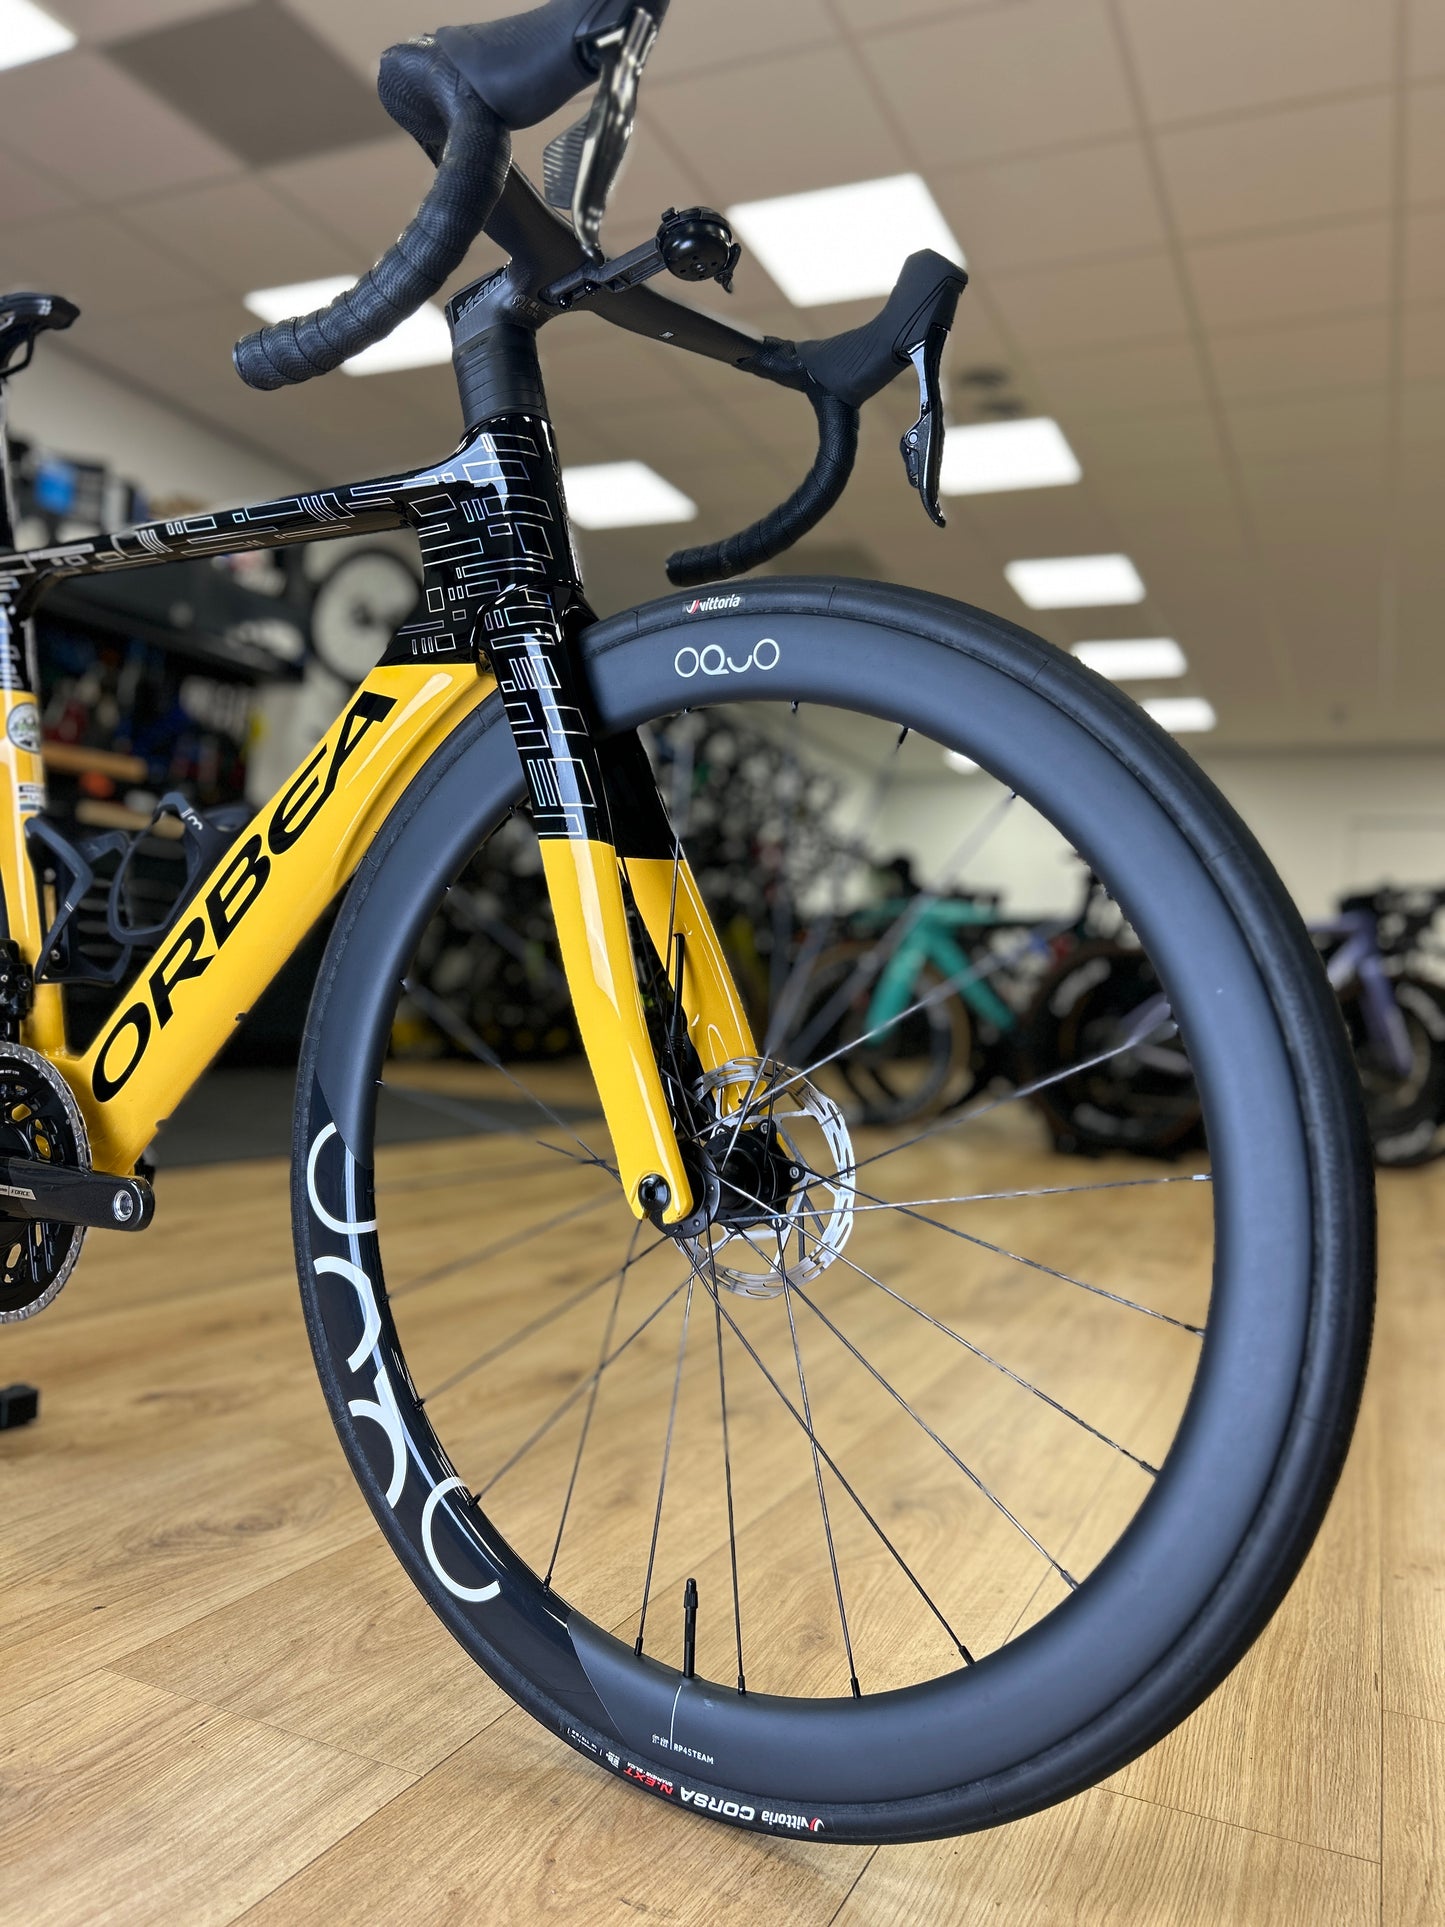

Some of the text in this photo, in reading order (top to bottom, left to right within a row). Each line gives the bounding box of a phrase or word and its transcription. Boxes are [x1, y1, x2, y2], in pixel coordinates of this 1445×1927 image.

[92, 690, 398, 1103] ORBEA
[680, 1786, 756, 1821] CORSA
[761, 1810, 809, 1831] vittoria
